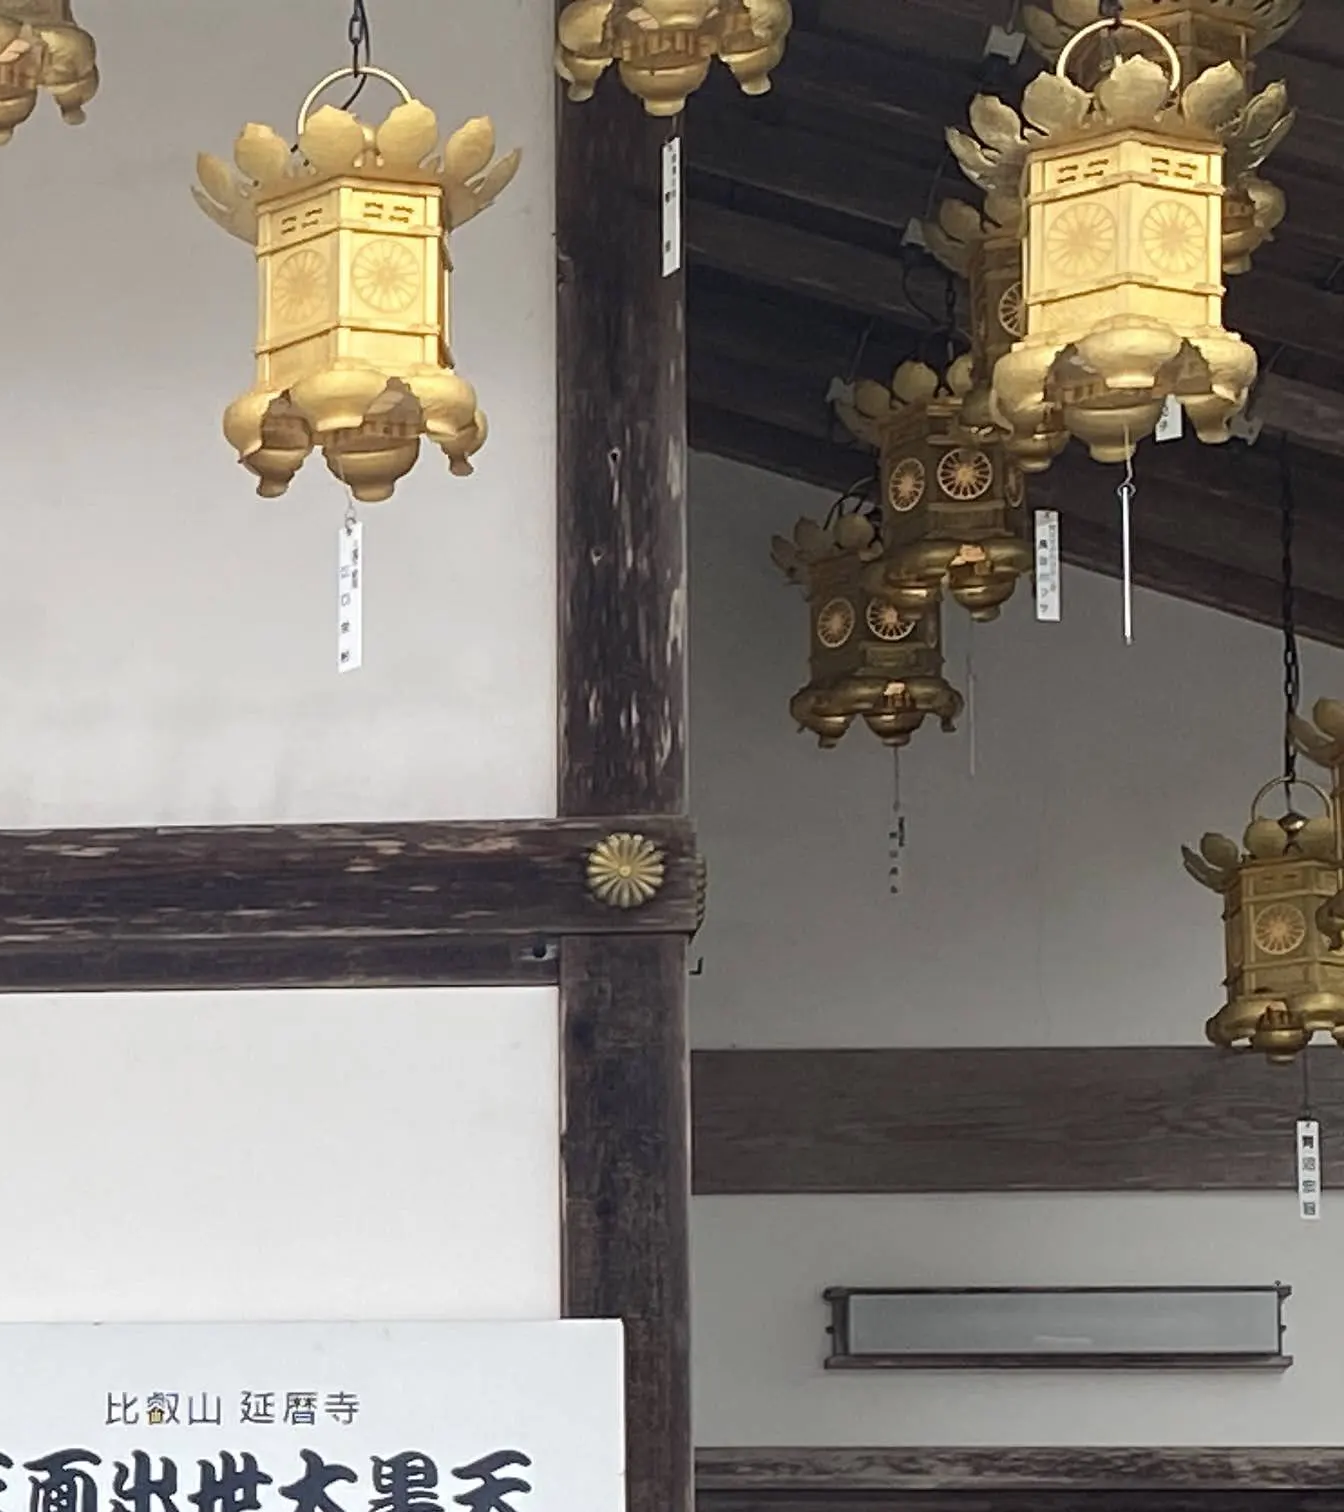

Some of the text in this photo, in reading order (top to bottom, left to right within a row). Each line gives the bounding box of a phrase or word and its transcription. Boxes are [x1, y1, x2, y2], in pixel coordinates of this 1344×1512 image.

[105, 1390, 359, 1426] 比叡山 延暦寺
